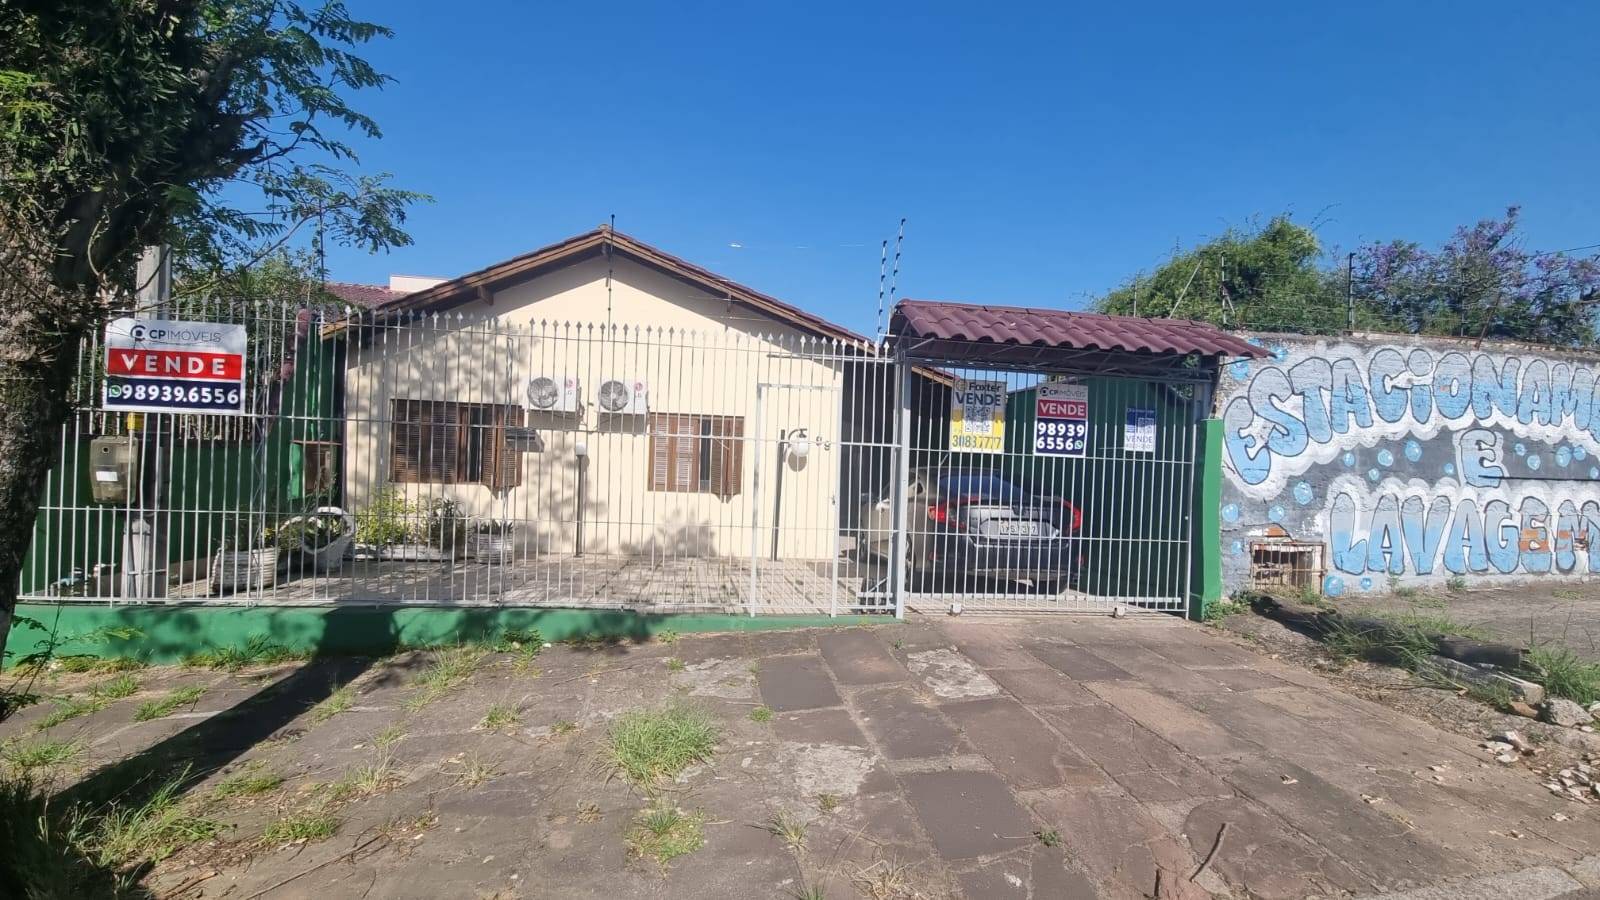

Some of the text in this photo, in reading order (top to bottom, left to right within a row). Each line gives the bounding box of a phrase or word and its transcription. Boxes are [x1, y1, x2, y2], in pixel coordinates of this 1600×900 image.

[121, 353, 226, 376] VENDE
[121, 384, 239, 405] 98939.6556
[955, 392, 1001, 407] VENDE
[1040, 402, 1086, 416] VENDE
[1038, 422, 1085, 437] 98939
[1036, 437, 1074, 451] 6556
[1459, 428, 1502, 488] E
[1329, 491, 1600, 576] LAVAGEM
